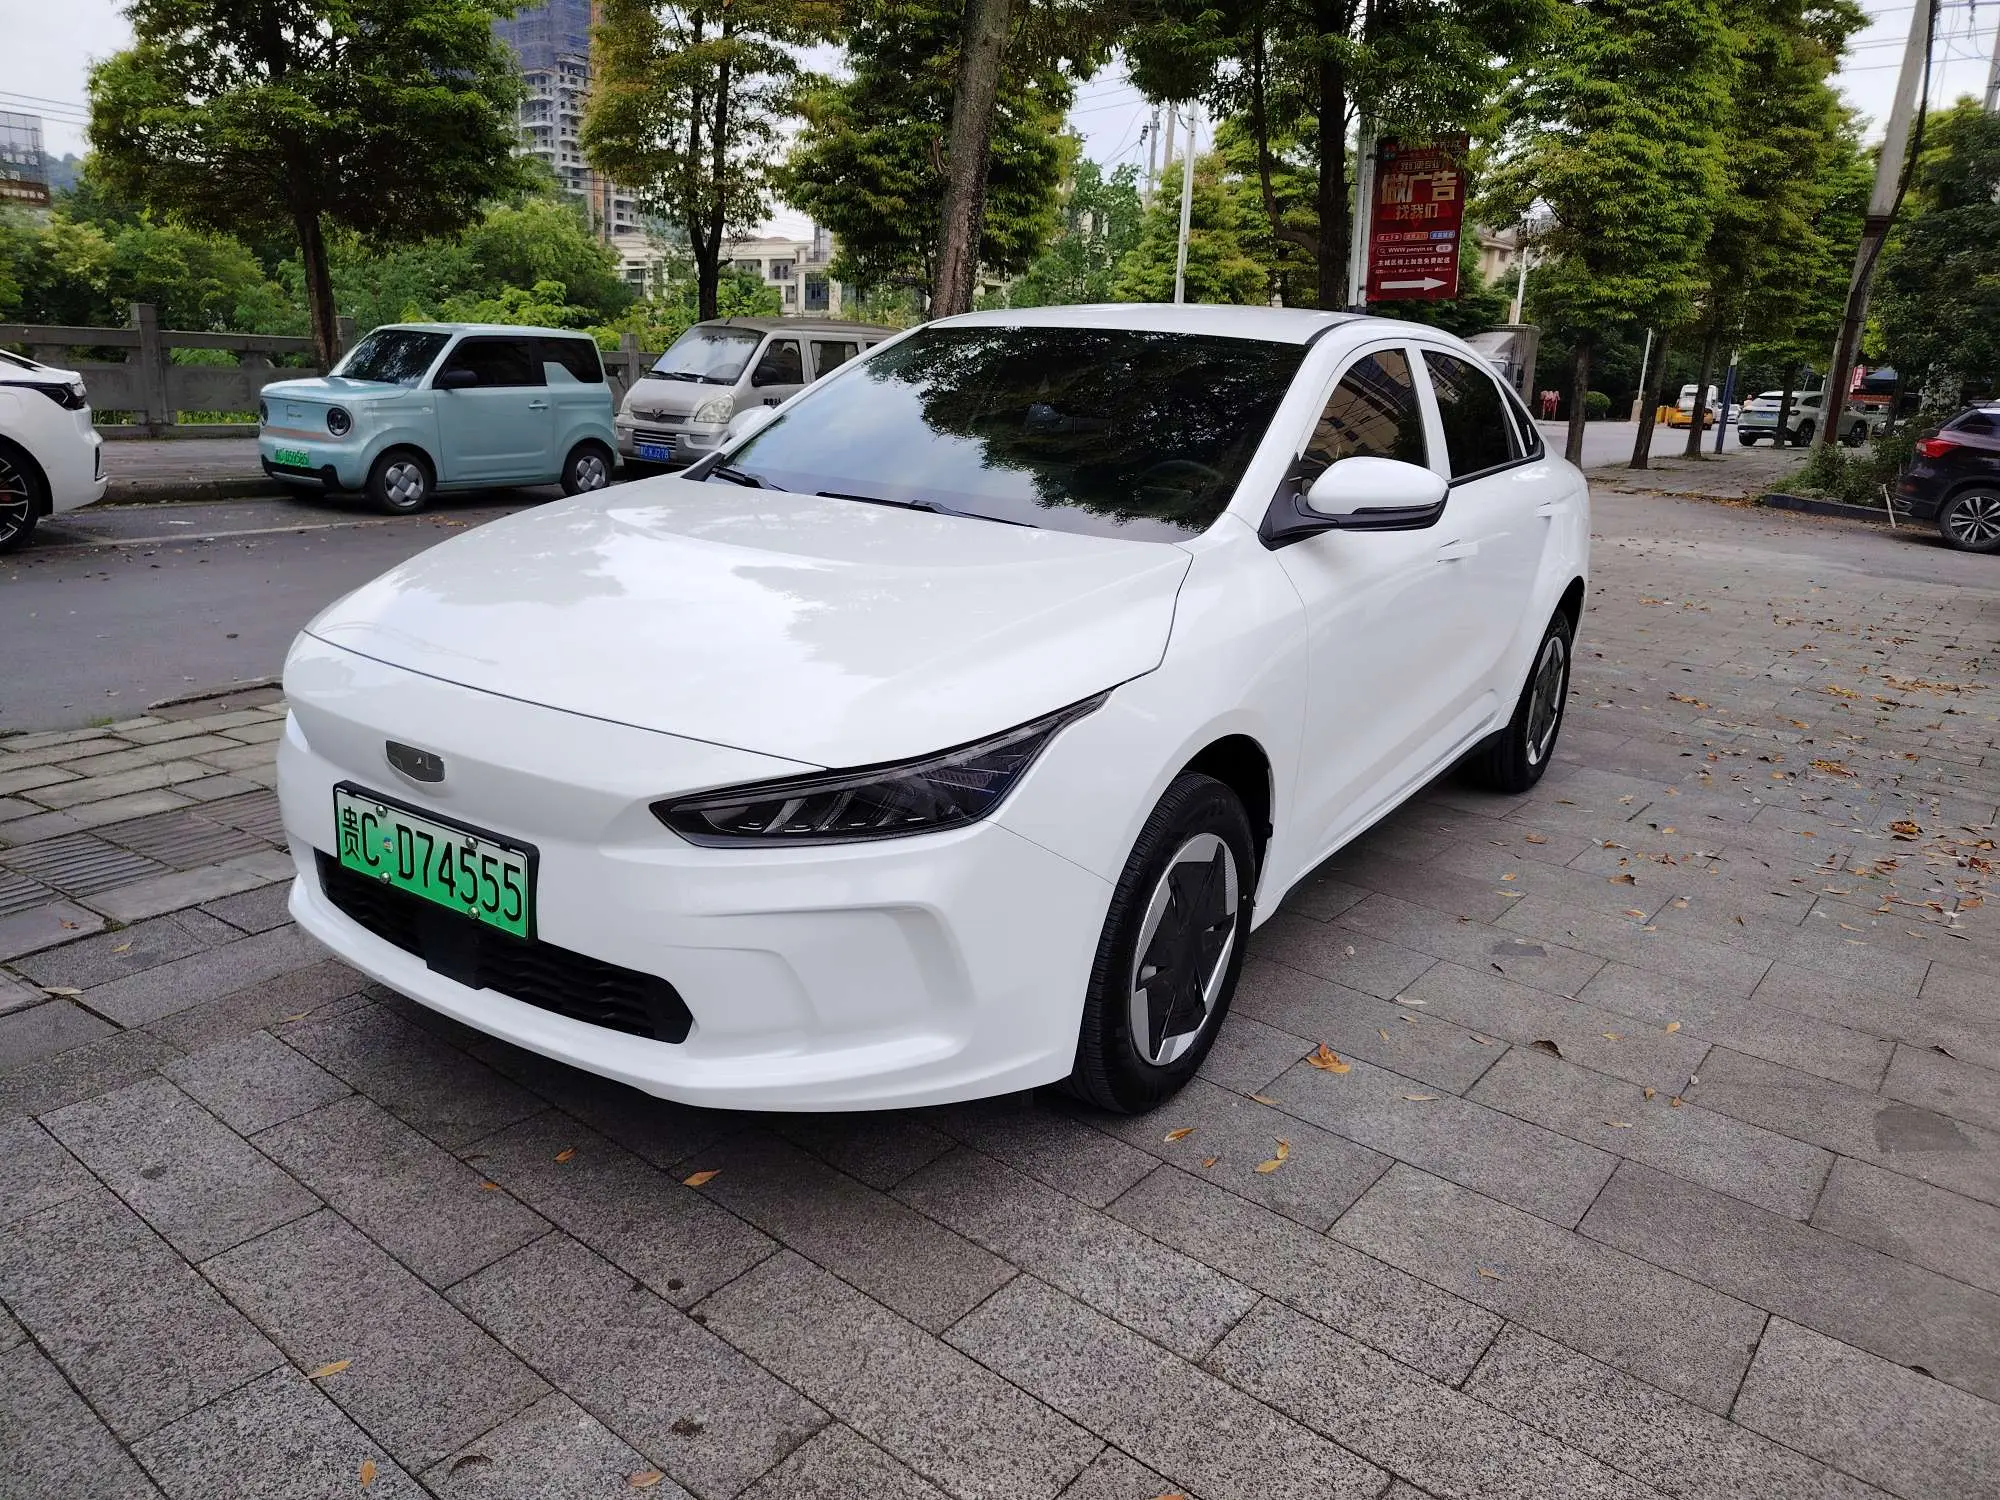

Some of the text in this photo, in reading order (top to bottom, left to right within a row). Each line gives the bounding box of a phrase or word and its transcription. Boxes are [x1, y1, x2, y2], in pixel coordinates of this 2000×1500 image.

[1381, 170, 1457, 204] 做广告
[1396, 203, 1439, 220] 找我们
